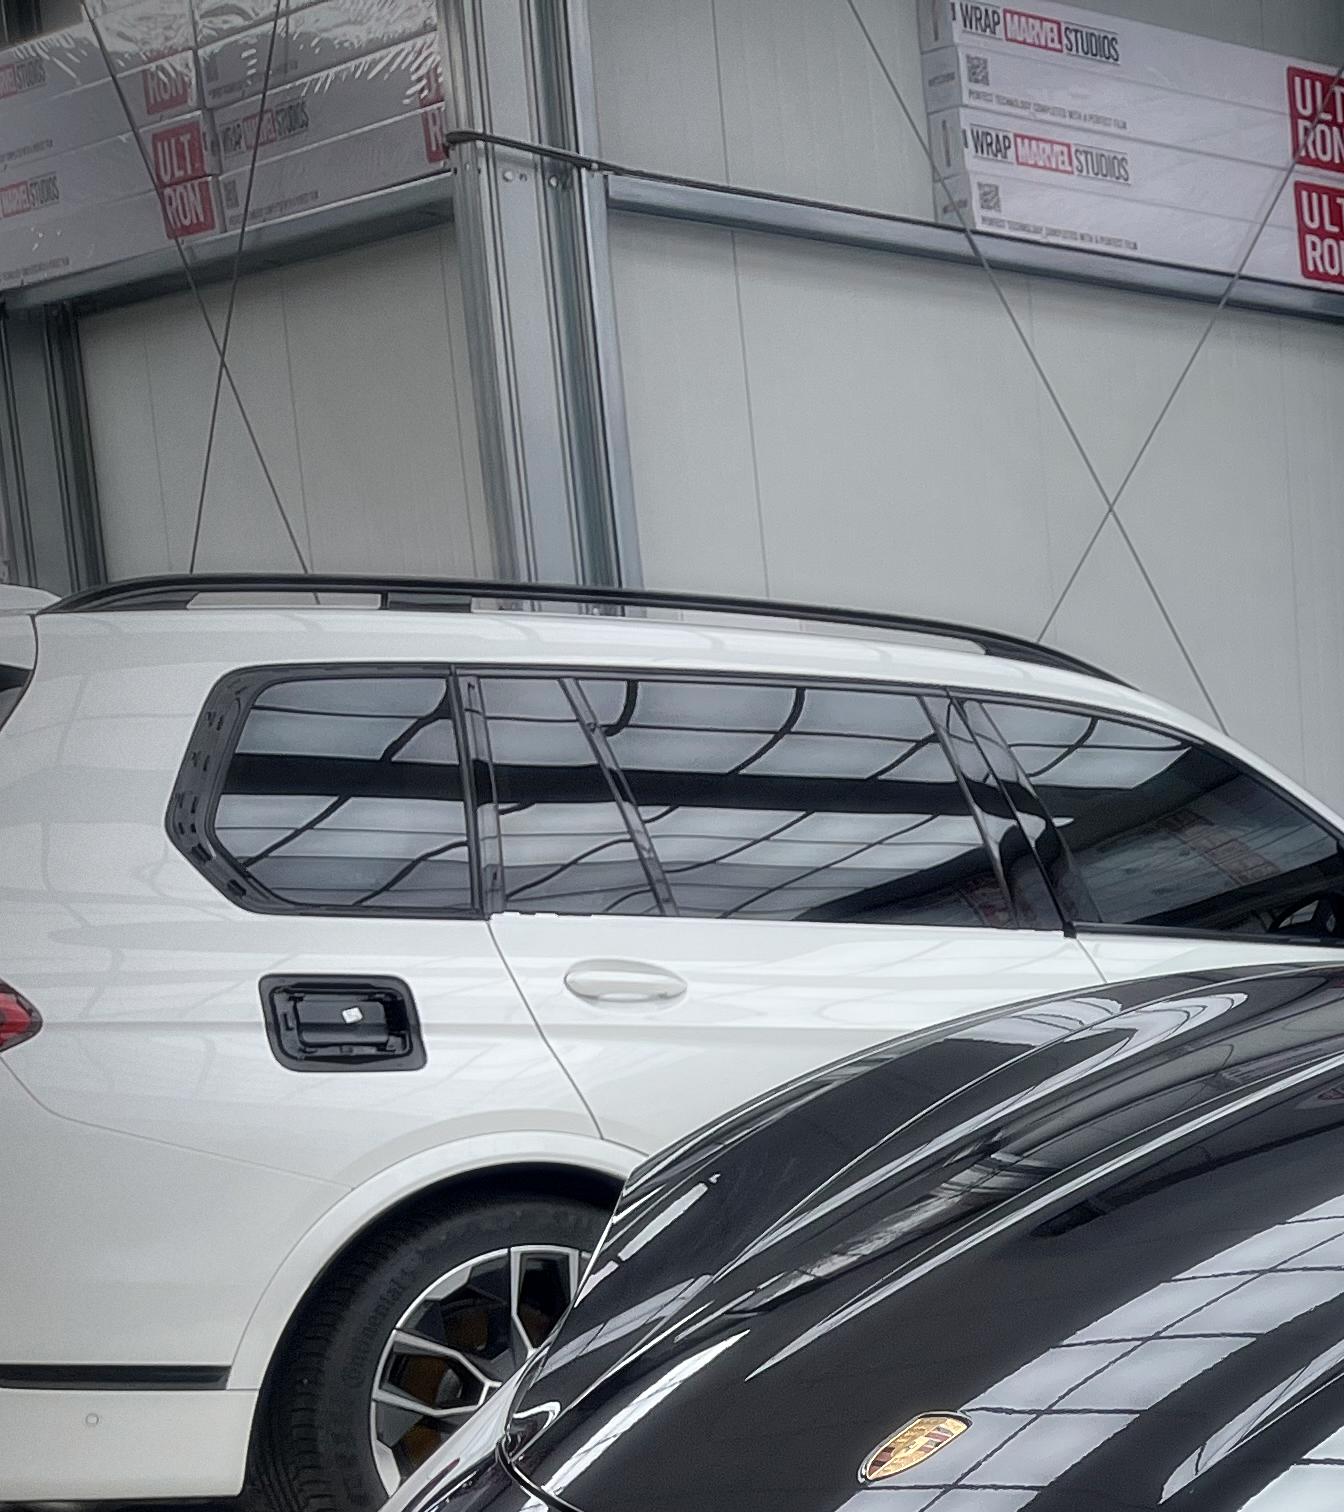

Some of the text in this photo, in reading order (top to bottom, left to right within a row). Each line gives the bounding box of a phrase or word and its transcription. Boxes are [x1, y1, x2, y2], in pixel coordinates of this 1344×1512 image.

[960, 2, 1120, 62] WRAP MARVEL STUDIOS
[156, 132, 192, 184] ULT
[971, 129, 1130, 182] WRAP MARVEL STUDIOS
[163, 178, 204, 229] RON
